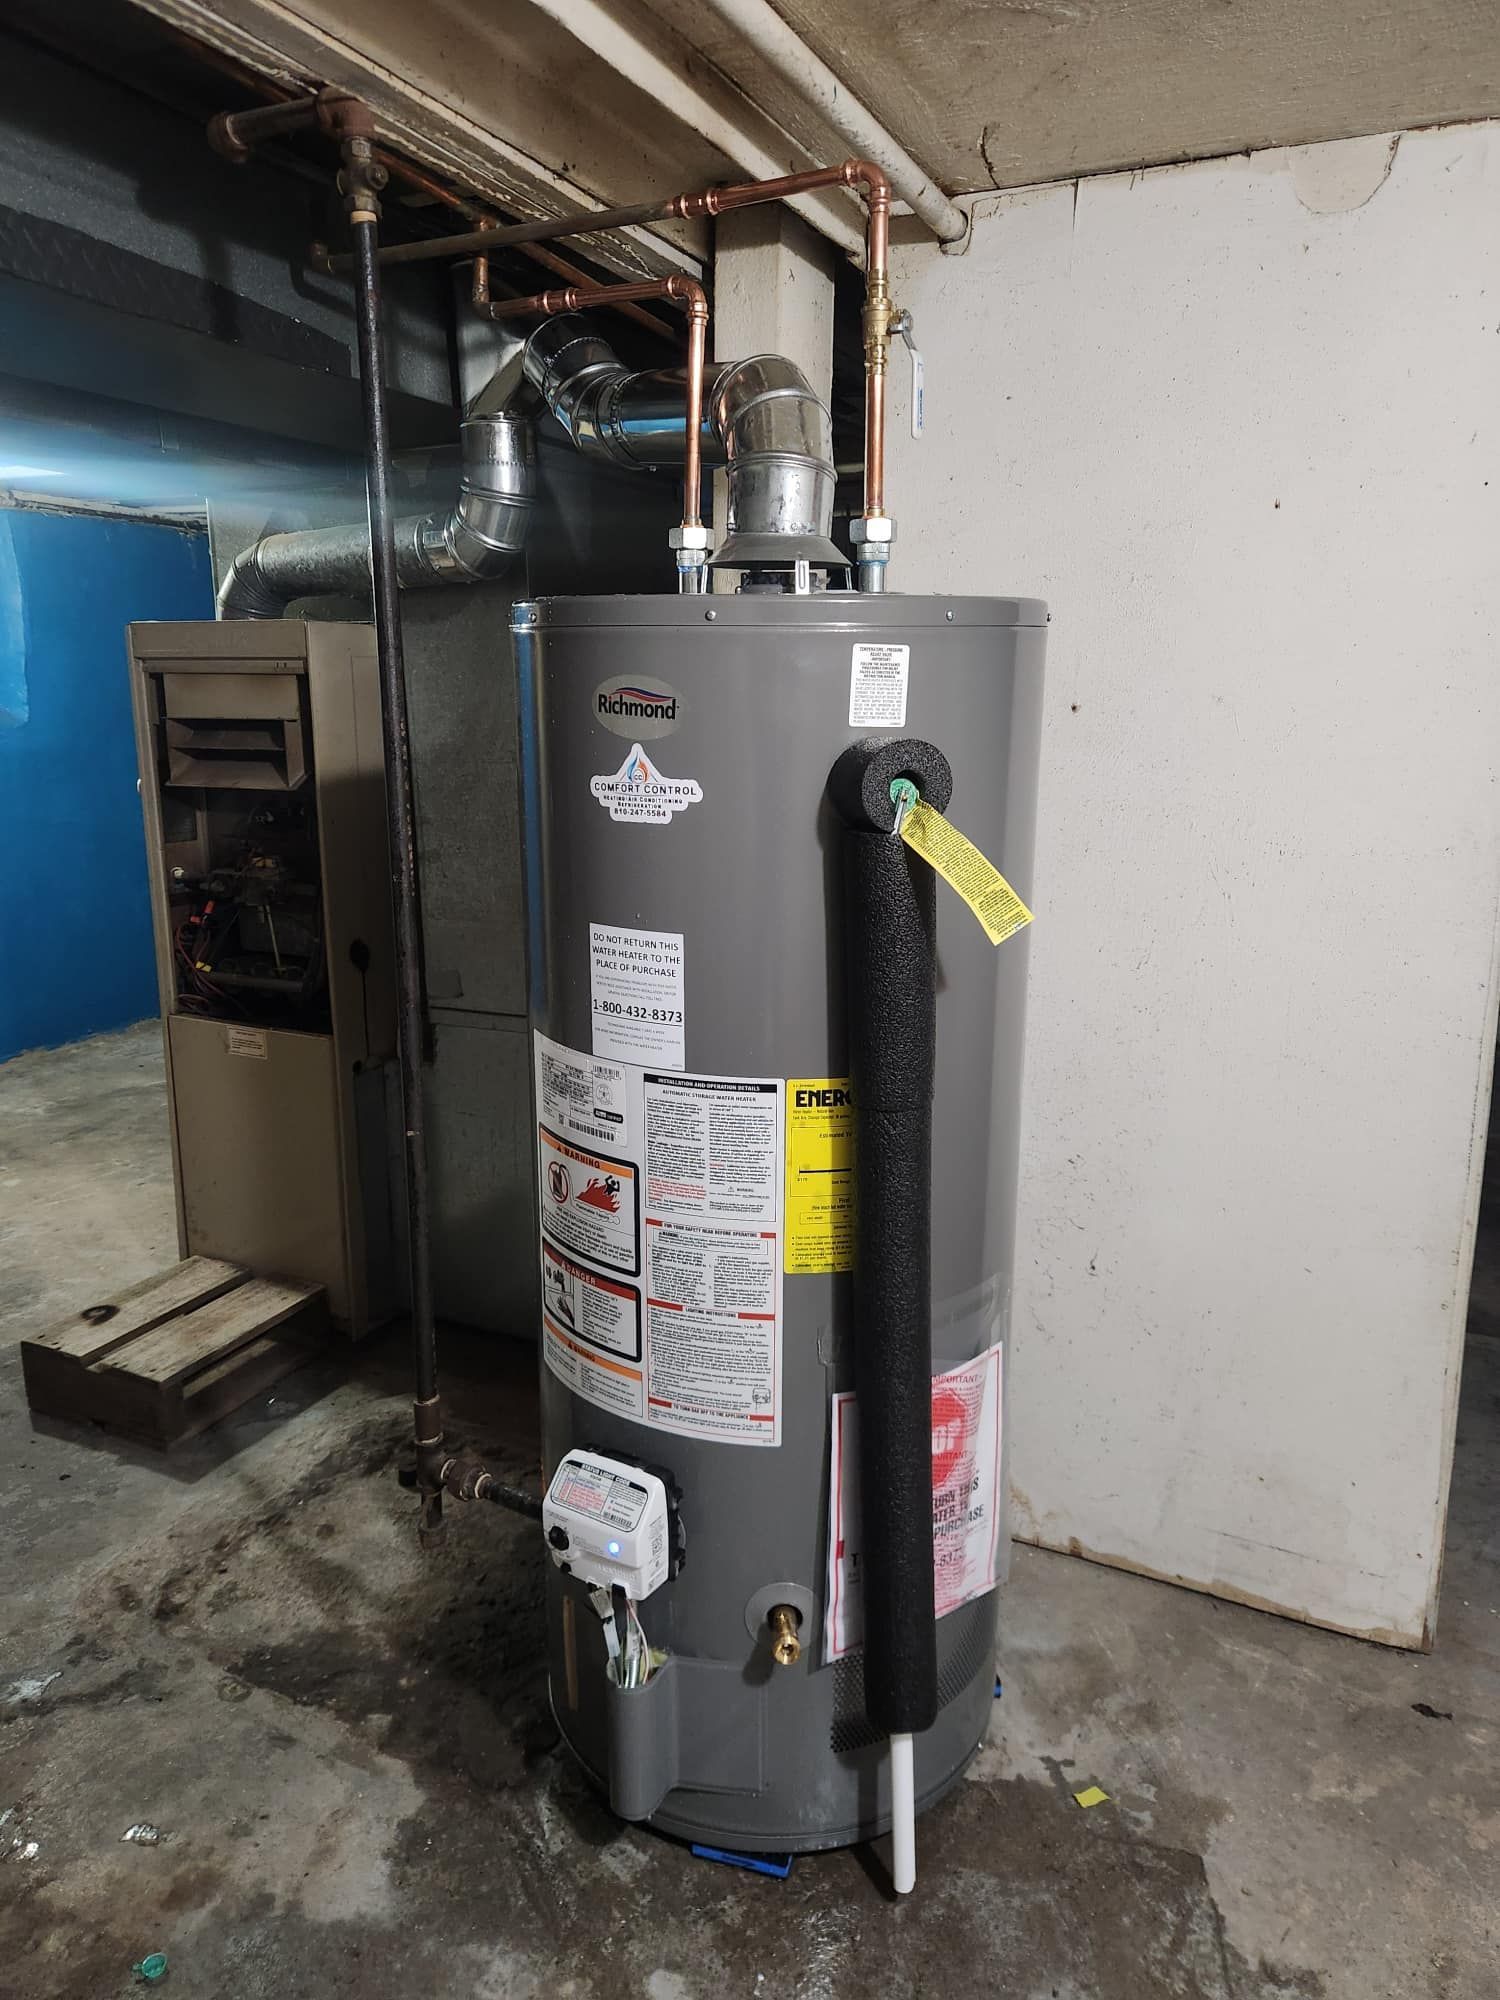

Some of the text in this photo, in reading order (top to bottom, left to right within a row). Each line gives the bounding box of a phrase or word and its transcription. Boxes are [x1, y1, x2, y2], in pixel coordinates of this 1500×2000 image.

[598, 694, 676, 720] Richmond
[594, 782, 696, 796] COMFORT CONTROL
[614, 808, 666, 817] 810-247-5584
[593, 932, 679, 951] DO NOT RETURN THIS
[591, 945, 681, 965] WATER HEATER TO THE
[596, 958, 677, 977] PLACE OF PURCHASE
[593, 999, 682, 1023] 1-800-432-8373
[657, 1078, 760, 1092] INSTALLATION AND OPERATION DETAILS
[662, 1089, 691, 1098] AUTOMATIC
[565, 1147, 601, 1169] WARNING
[567, 1264, 596, 1285] DANGER
